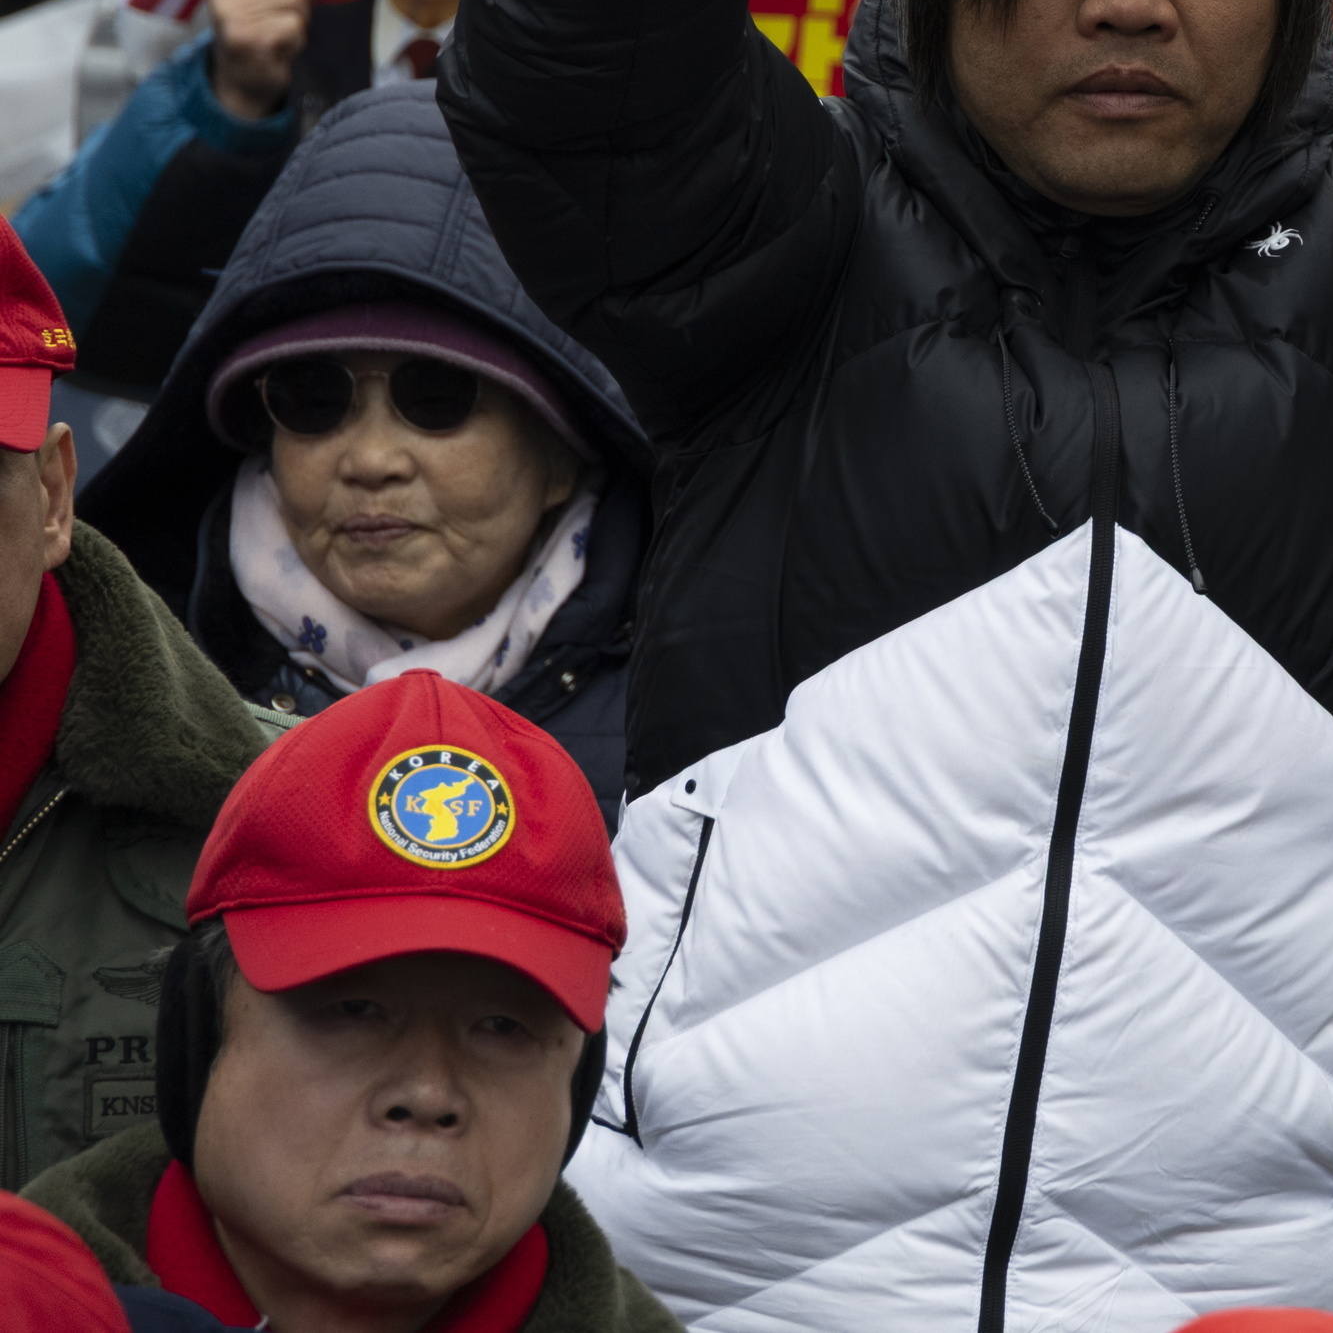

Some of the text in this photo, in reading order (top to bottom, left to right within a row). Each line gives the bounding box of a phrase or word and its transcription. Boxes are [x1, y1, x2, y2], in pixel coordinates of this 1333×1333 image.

[388, 751, 500, 791] KOREA
[379, 810, 506, 863] National Security Federation
[100, 1095, 160, 1117] KNS
